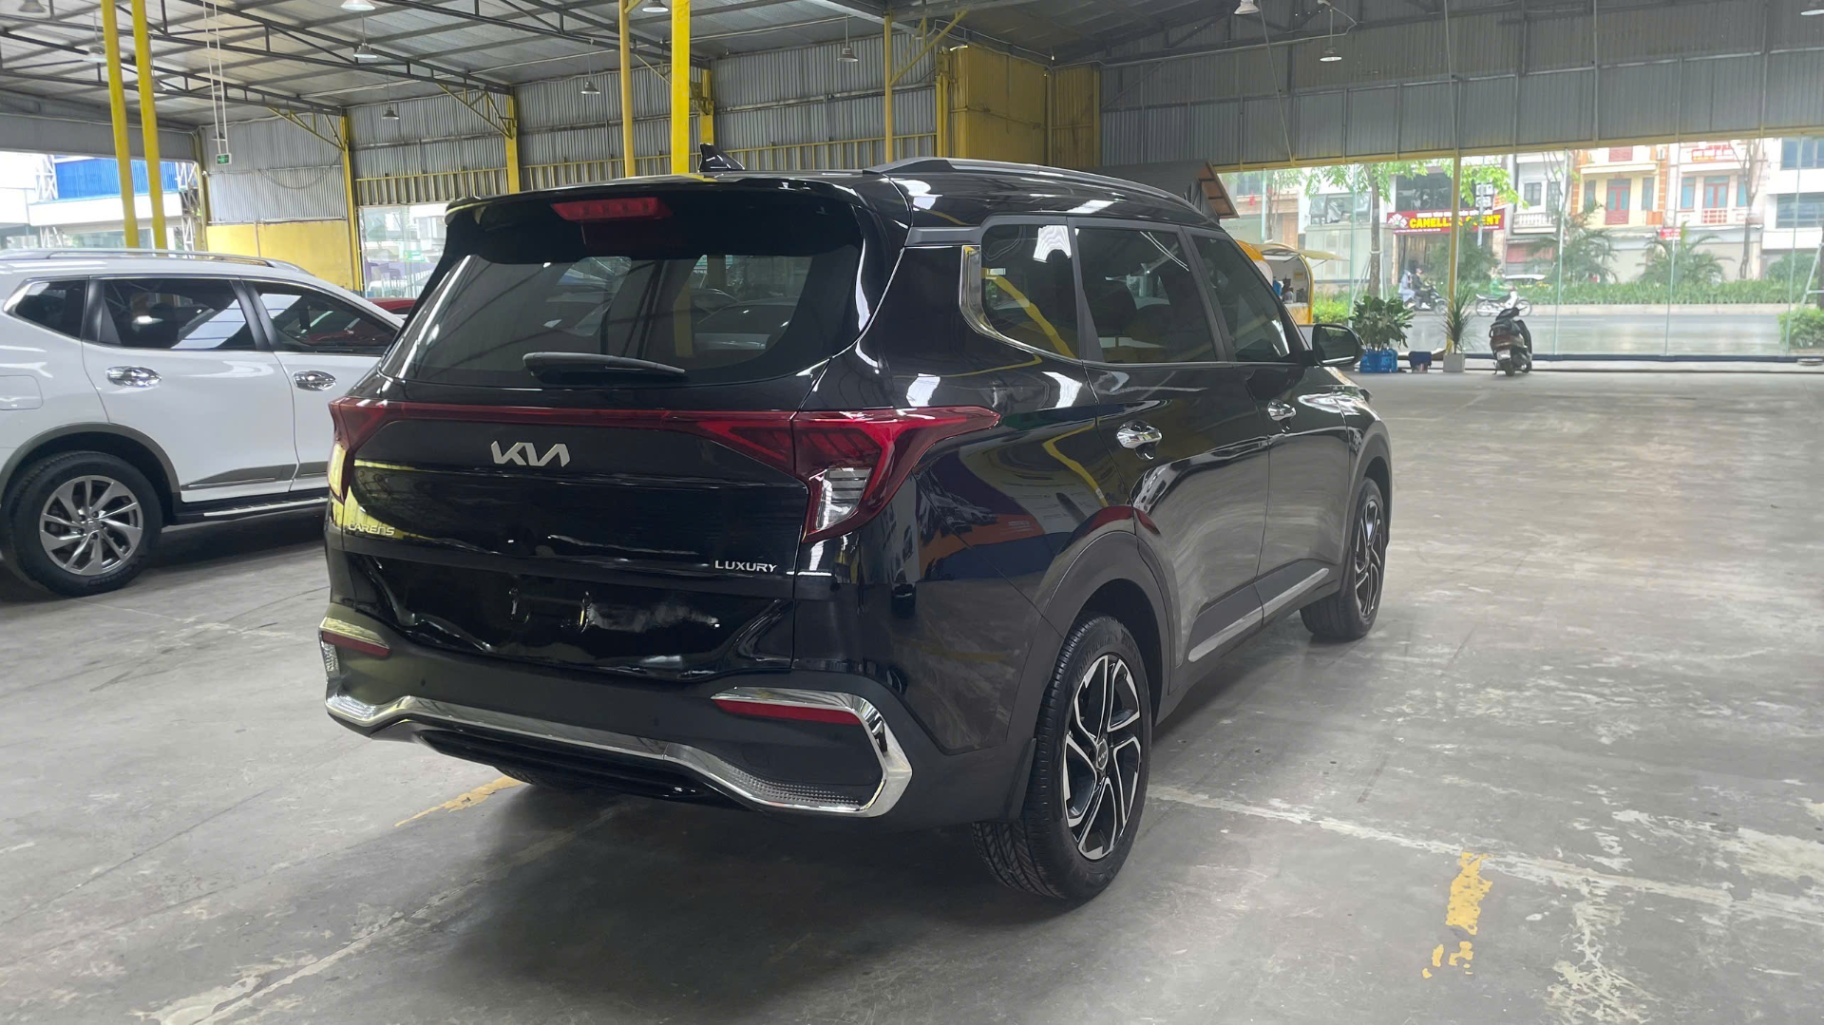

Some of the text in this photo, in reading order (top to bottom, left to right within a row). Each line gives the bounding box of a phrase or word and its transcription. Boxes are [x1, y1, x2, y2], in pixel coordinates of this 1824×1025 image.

[1465, 214, 1501, 226] ENT
[491, 440, 570, 467] KIA
[348, 522, 396, 536] CARENS
[714, 560, 778, 573] LUXURY
